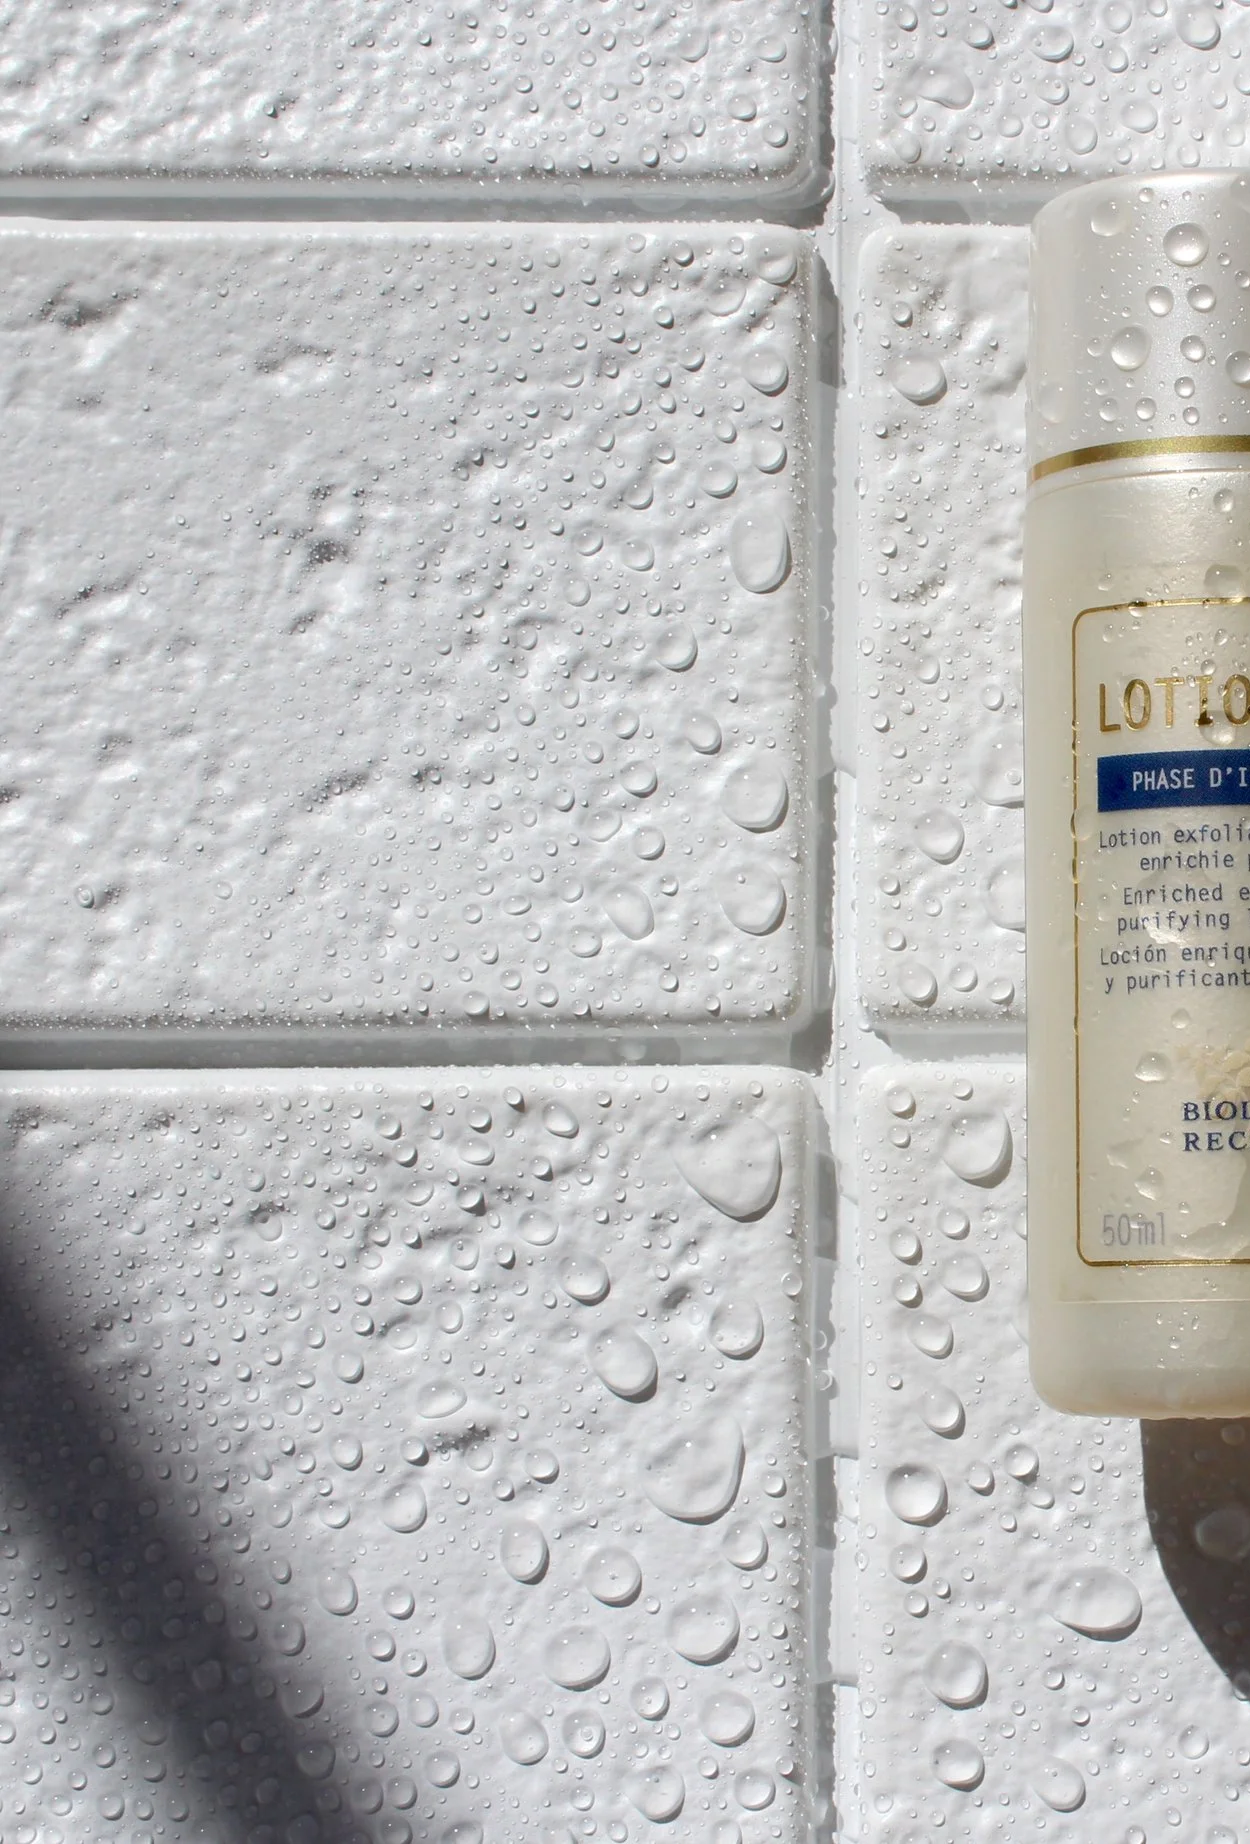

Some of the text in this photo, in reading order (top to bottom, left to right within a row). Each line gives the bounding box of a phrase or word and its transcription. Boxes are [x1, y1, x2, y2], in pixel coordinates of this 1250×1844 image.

[1132, 769, 1195, 792] PHASE
[1099, 828, 1161, 849] Lotion
[1140, 851, 1234, 871] enrichie
[1123, 883, 1223, 906] Enriched
[1117, 909, 1230, 935] purifying
[1100, 943, 1167, 966] Loción
[1105, 975, 1113, 994] y
[1103, 1211, 1166, 1247] 50ml
